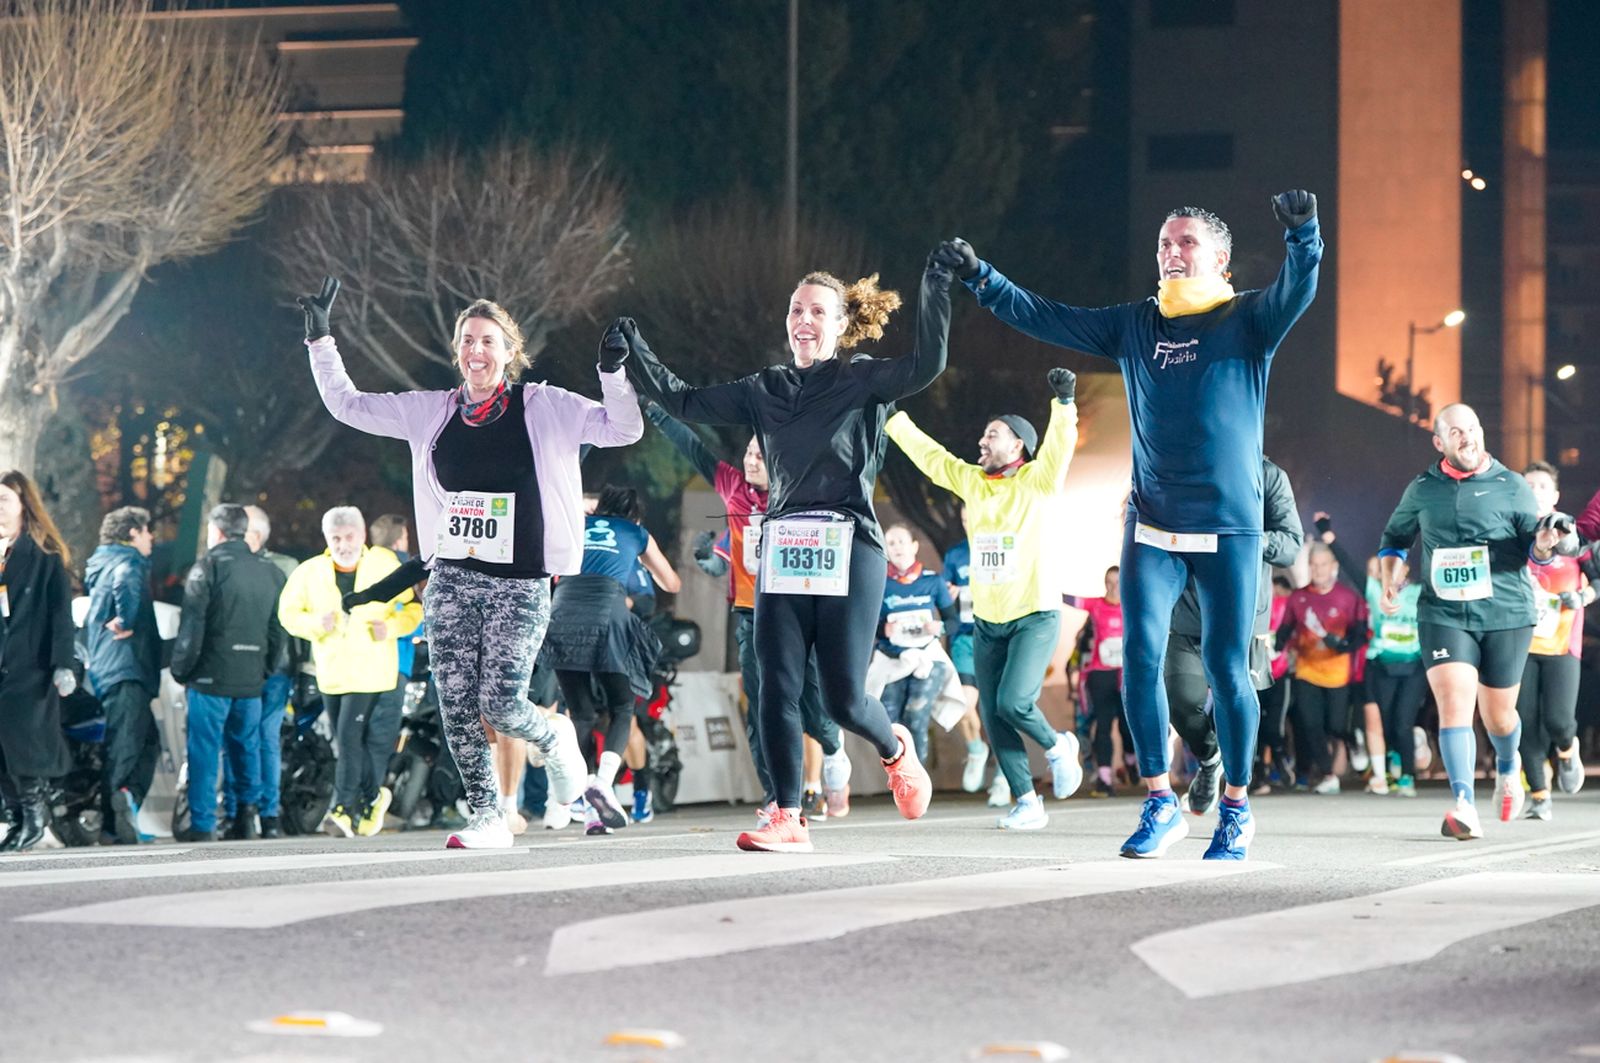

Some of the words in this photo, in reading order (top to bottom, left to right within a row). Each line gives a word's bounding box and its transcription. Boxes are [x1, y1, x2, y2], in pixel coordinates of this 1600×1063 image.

[448, 515, 498, 539] 3780
[787, 529, 810, 537] NOCHE
[810, 529, 820, 538] DE
[778, 537, 794, 546] SAN
[779, 547, 836, 570] 13319
[981, 551, 1006, 567] 7701
[1443, 566, 1478, 584] 6791
